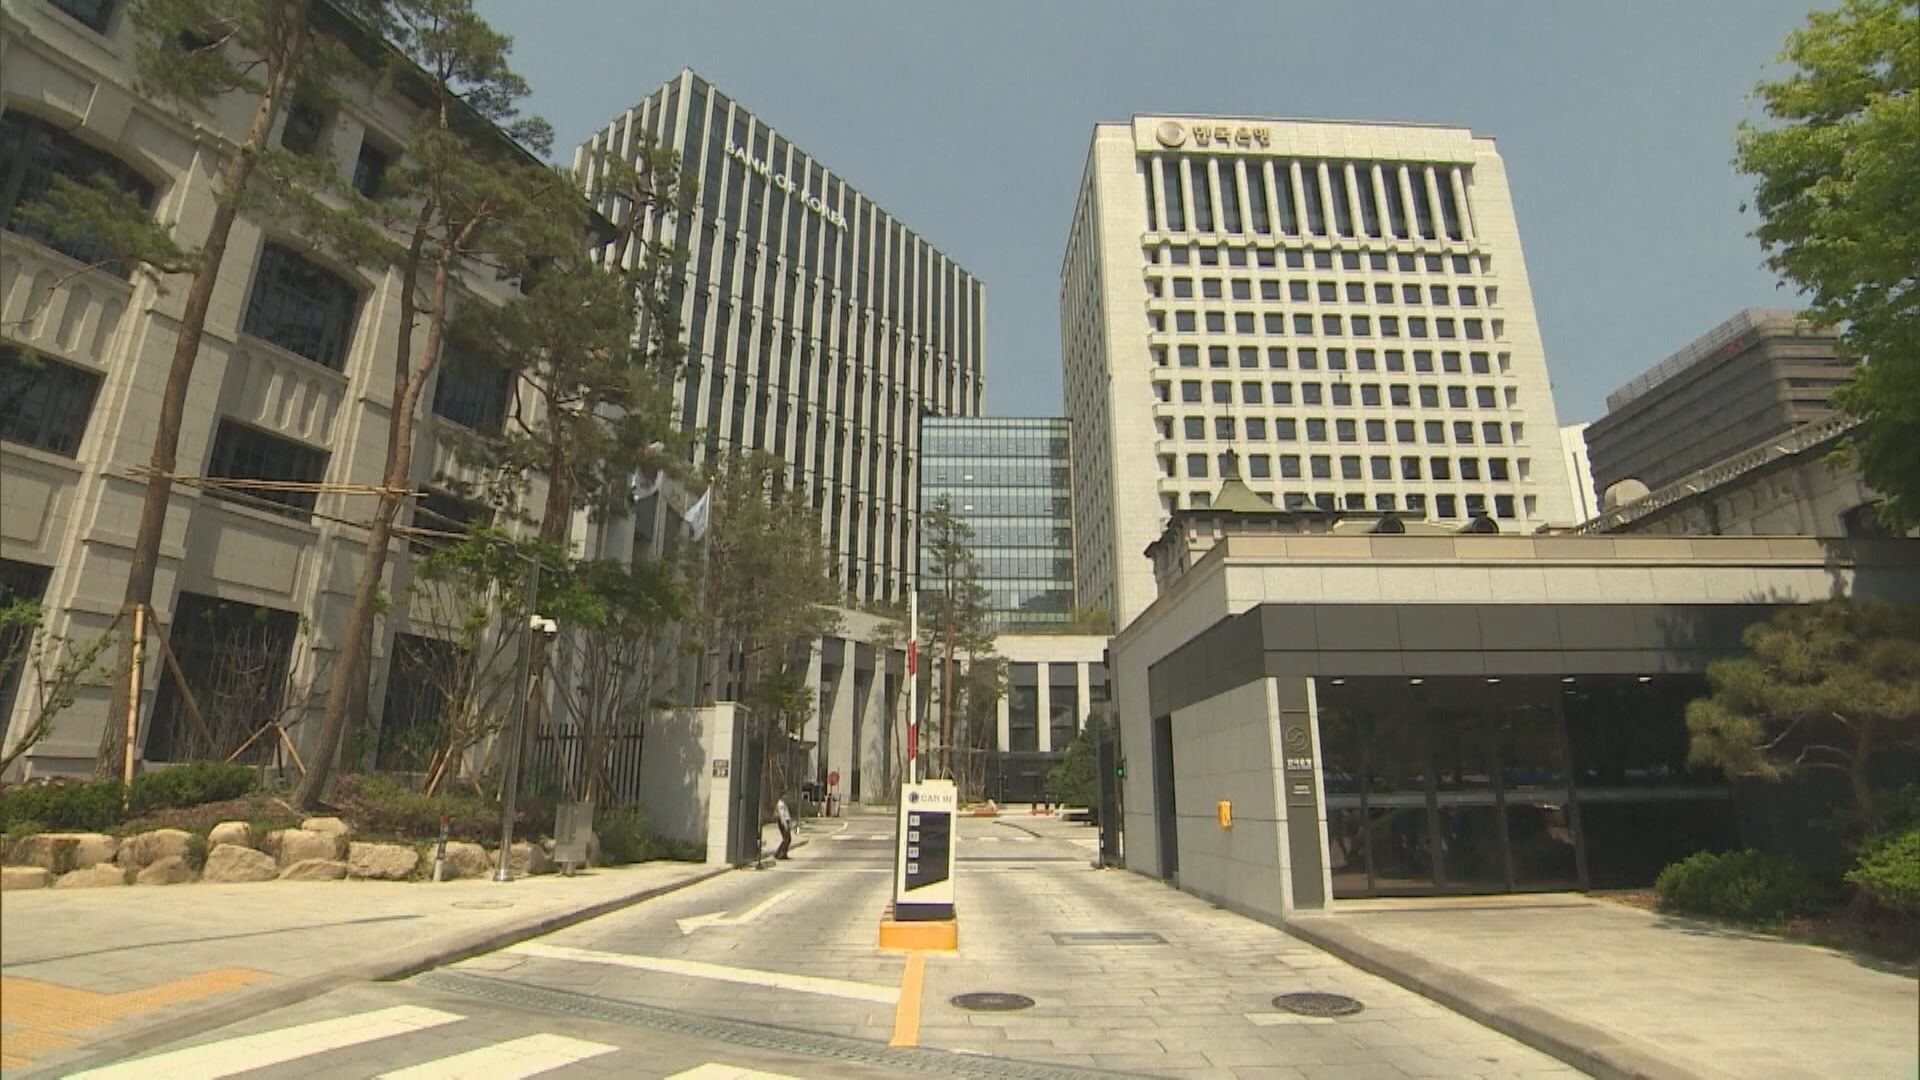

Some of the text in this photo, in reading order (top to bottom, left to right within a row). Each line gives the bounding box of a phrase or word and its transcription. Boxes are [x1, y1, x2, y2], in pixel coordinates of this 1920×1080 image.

[1192, 125, 1270, 148] 한국은행
[725, 140, 848, 232] BANK OF KOREA
[920, 793, 940, 803] CAR
[942, 794, 952, 803] IN
